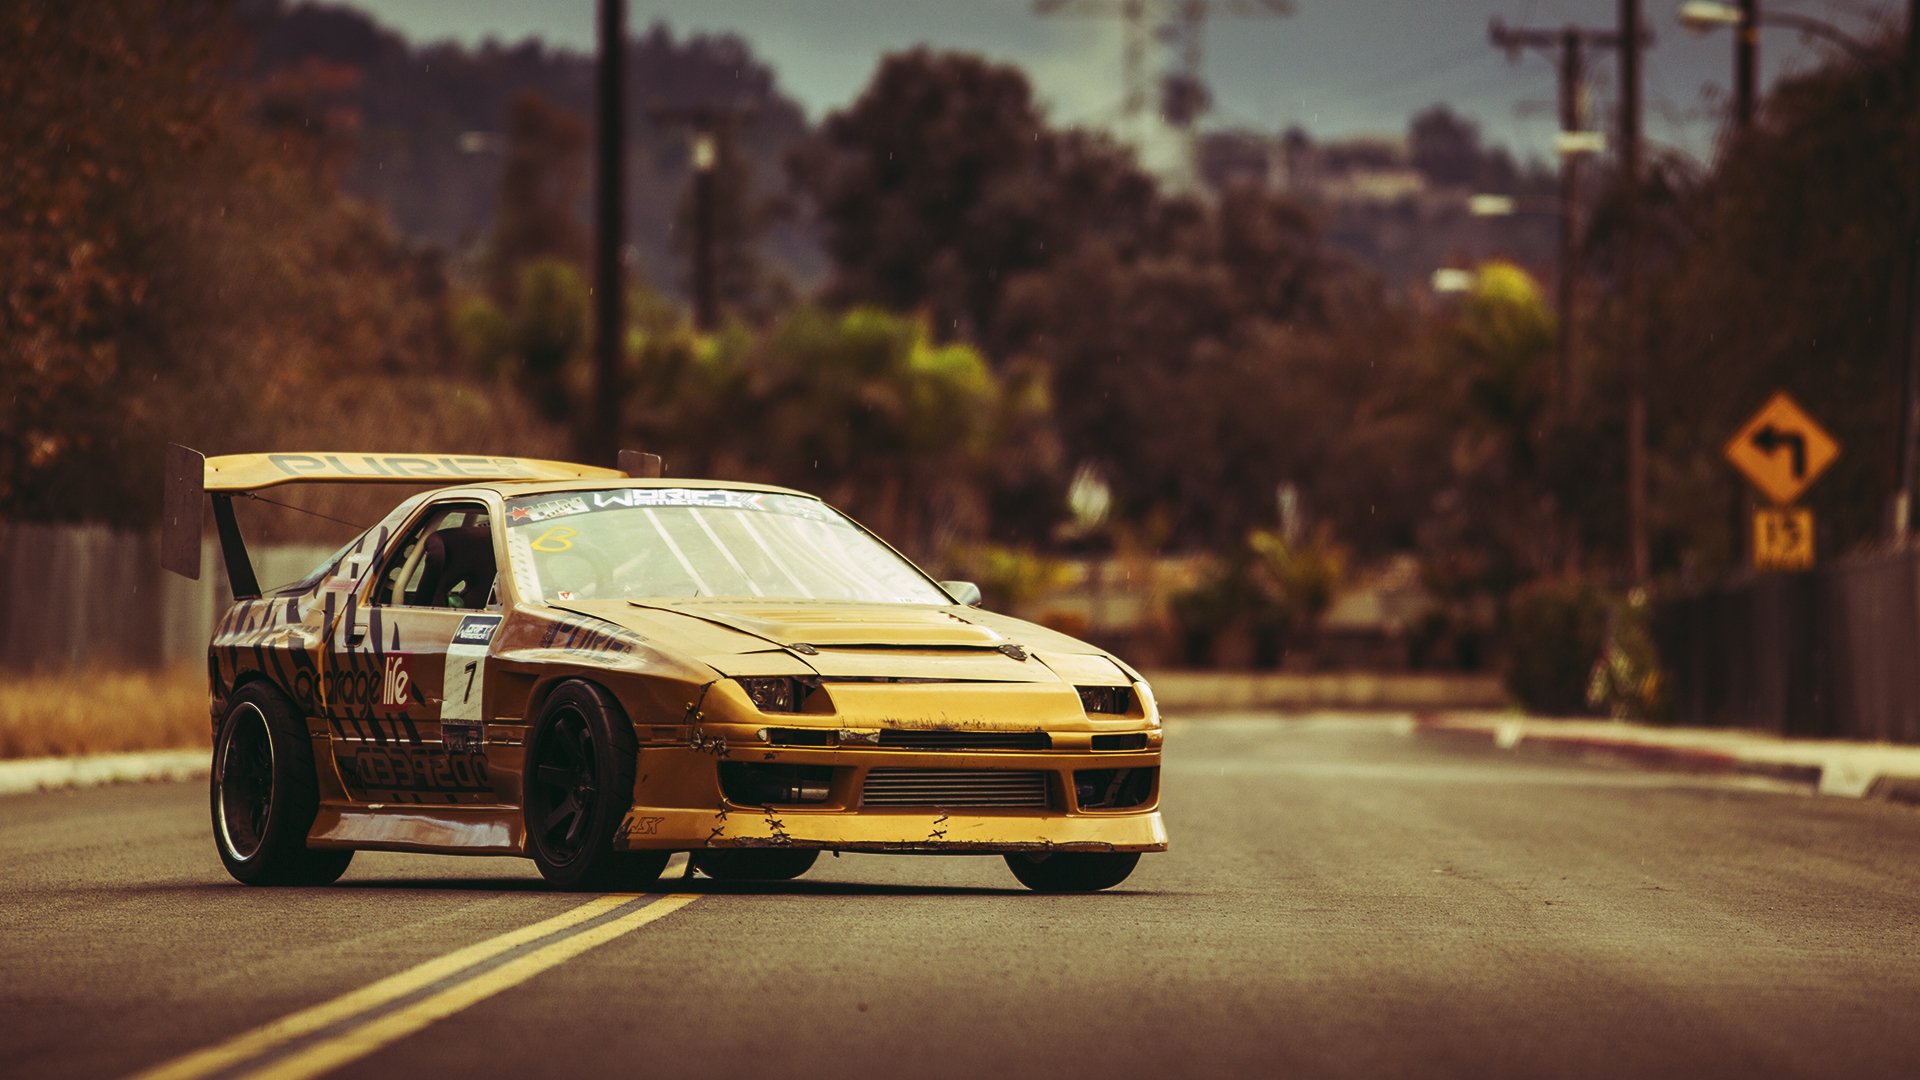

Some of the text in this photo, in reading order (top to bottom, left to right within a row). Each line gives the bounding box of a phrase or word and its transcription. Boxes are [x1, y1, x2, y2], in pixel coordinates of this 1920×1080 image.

[268, 455, 492, 476] PURE
[633, 489, 741, 500] DRIFT
[531, 525, 577, 552] B
[383, 657, 409, 705] life
